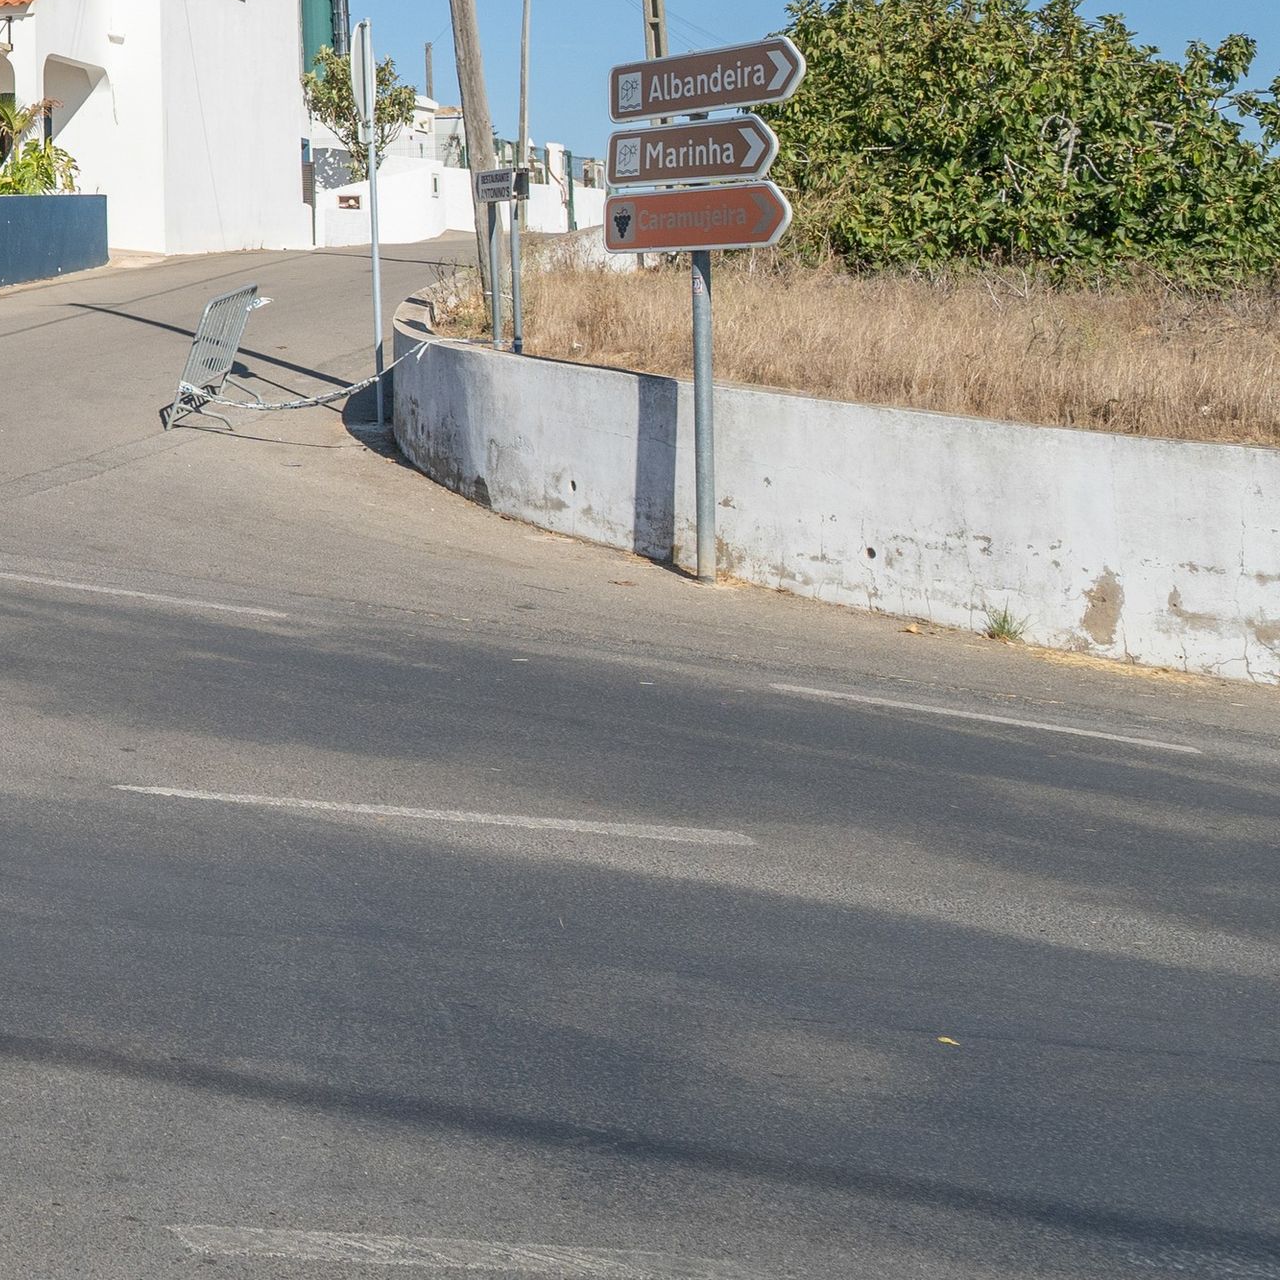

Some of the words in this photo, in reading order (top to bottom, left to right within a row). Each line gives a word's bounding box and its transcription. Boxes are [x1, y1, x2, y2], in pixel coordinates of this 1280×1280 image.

[649, 61, 765, 102] Albandeira
[646, 137, 735, 169] Marinha
[640, 205, 746, 232] Caramujeira
